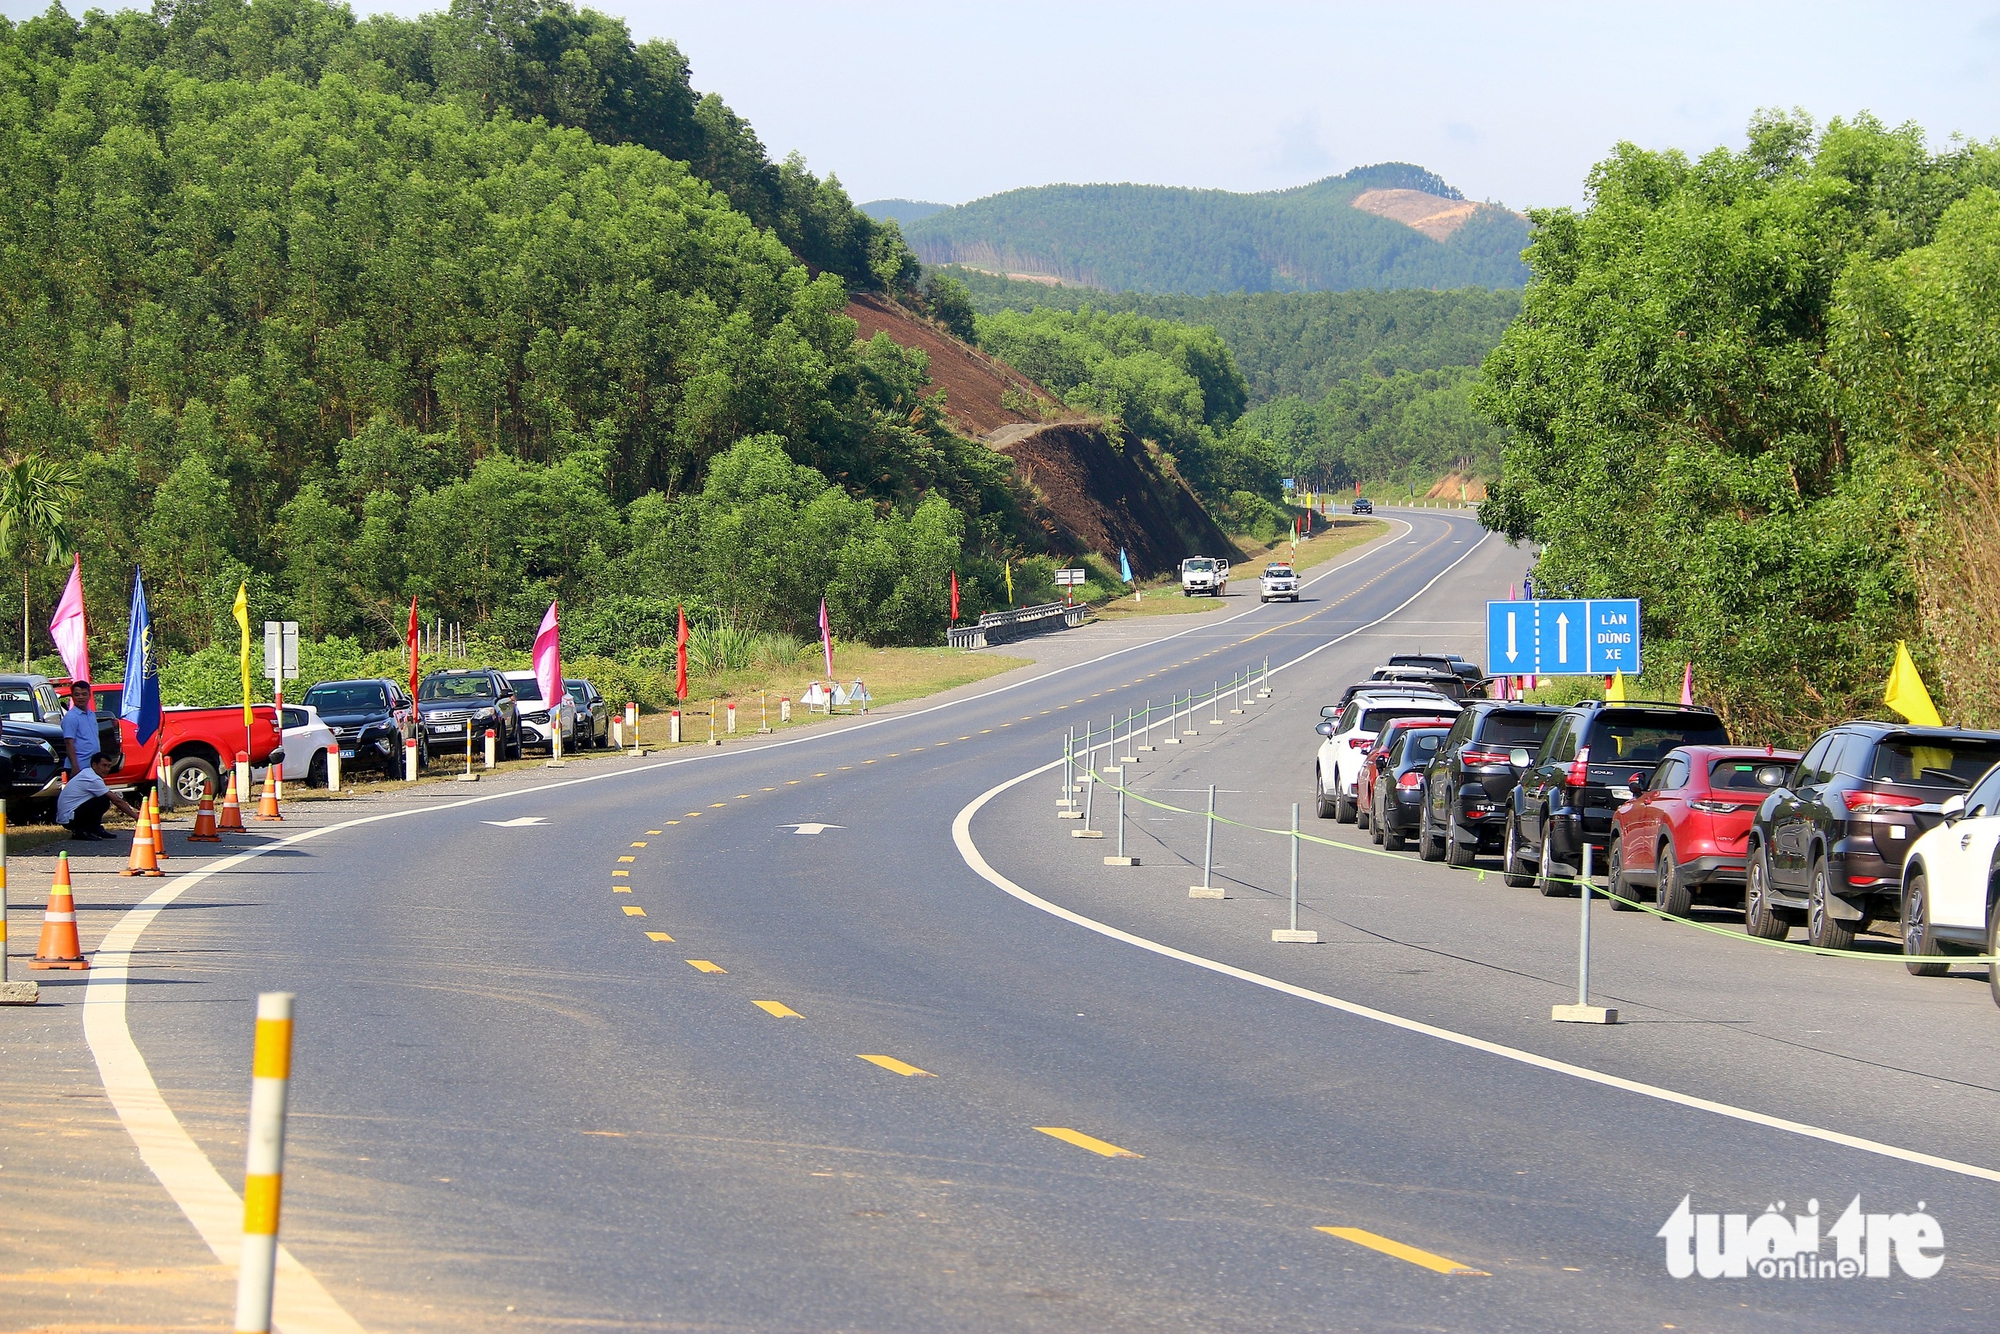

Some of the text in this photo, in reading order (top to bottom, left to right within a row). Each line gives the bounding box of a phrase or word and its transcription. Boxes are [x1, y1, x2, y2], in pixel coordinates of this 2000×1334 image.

[1601, 610, 1627, 625] LÀN
[1597, 630, 1631, 644] DỪNG
[1605, 648, 1622, 660] XE
